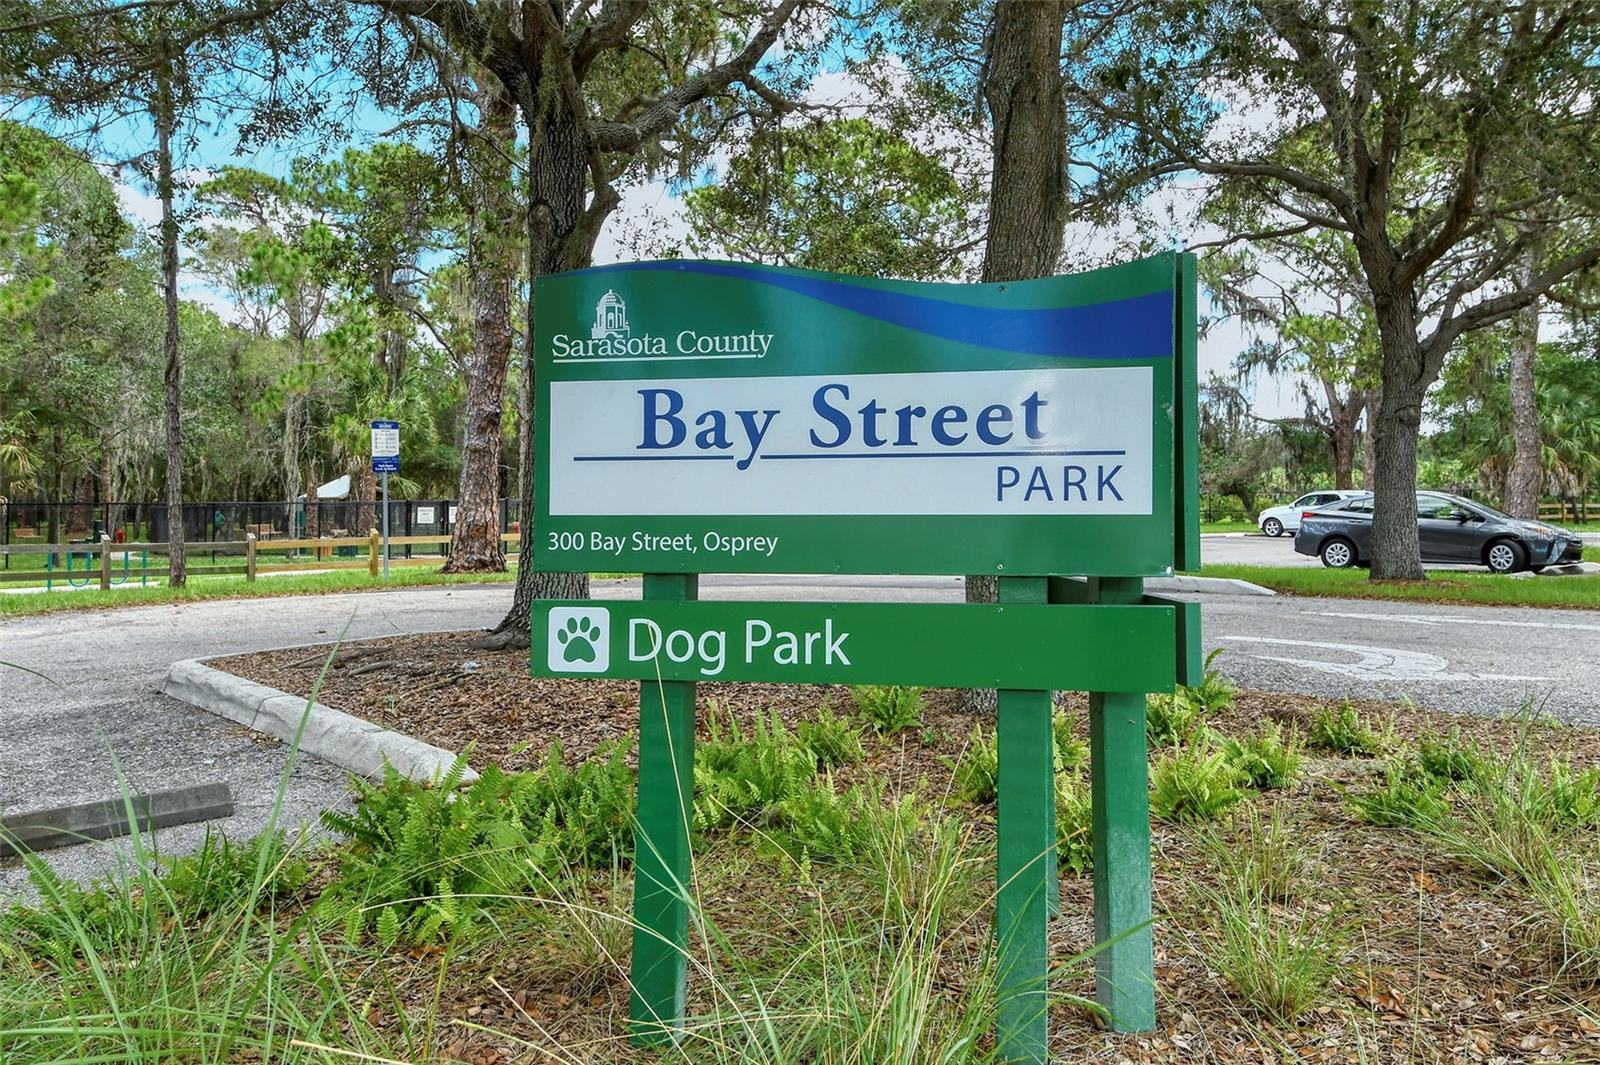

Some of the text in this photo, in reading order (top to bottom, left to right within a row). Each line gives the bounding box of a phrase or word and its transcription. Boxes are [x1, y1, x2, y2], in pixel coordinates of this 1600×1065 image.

[553, 331, 773, 359] Sarasota County
[637, 384, 1050, 471] Bay Street
[997, 465, 1124, 502] PARK
[548, 532, 778, 557] 300 Bay Street, Osprey
[628, 618, 851, 676] Dog Park
